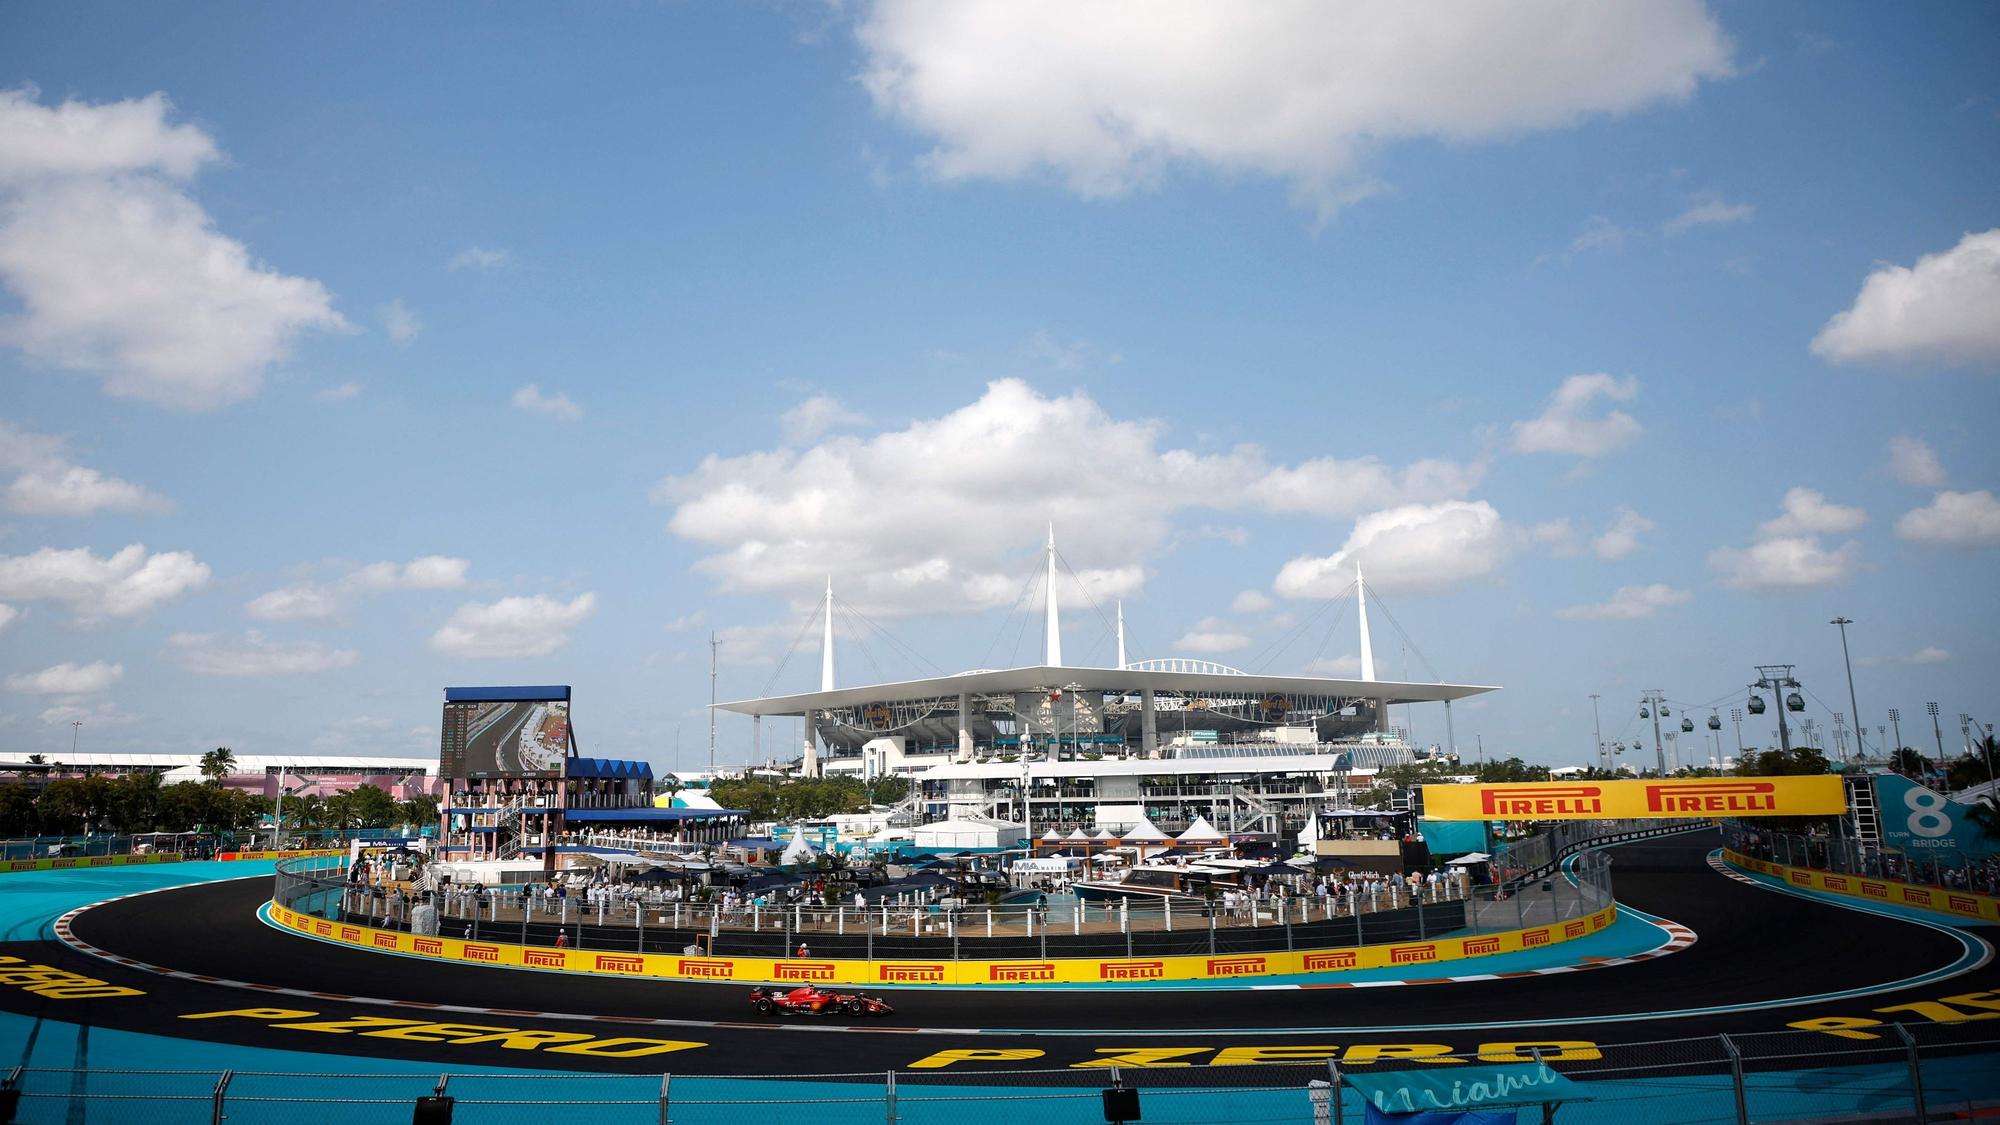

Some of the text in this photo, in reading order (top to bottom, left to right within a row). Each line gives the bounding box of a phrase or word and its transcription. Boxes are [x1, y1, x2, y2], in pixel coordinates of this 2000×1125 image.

[1481, 788, 1600, 816] PIRELLI
[1647, 783, 1776, 813] PIRELLI
[1903, 786, 1953, 838] 8
[1888, 831, 1910, 839] TURN
[1912, 839, 1957, 848] BRIDGE
[1015, 862, 1040, 871] MIA
[1824, 876, 1848, 890] PIRELLI
[1862, 882, 1887, 898] PIRELLI
[1904, 888, 1931, 905] PIRELLI
[1949, 895, 1979, 914] PIRELLI
[374, 933, 399, 948] PIRELLI
[413, 938, 444, 954] PIRELLI
[1463, 937, 1500, 955] PIRELLI
[1522, 929, 1550, 947] PIRELLI
[464, 945, 499, 961] PIRELLI
[524, 950, 566, 967] PIRELLI
[1303, 952, 1356, 970] PIRELLI
[1390, 945, 1436, 962] PIRELLI
[595, 955, 644, 972] PIRELLI
[678, 960, 734, 977] PIRELLI
[774, 963, 835, 980] PIRELLI
[1100, 961, 1164, 979] PIRELLI
[1207, 958, 1266, 975] PIRELLI
[880, 964, 944, 981] PIRELLI
[990, 964, 1055, 981] PIRELLI
[177, 1008, 708, 1059] P ZERO
[907, 1041, 1602, 1069] P ZERO
[1373, 1063, 1557, 1115] Miami
